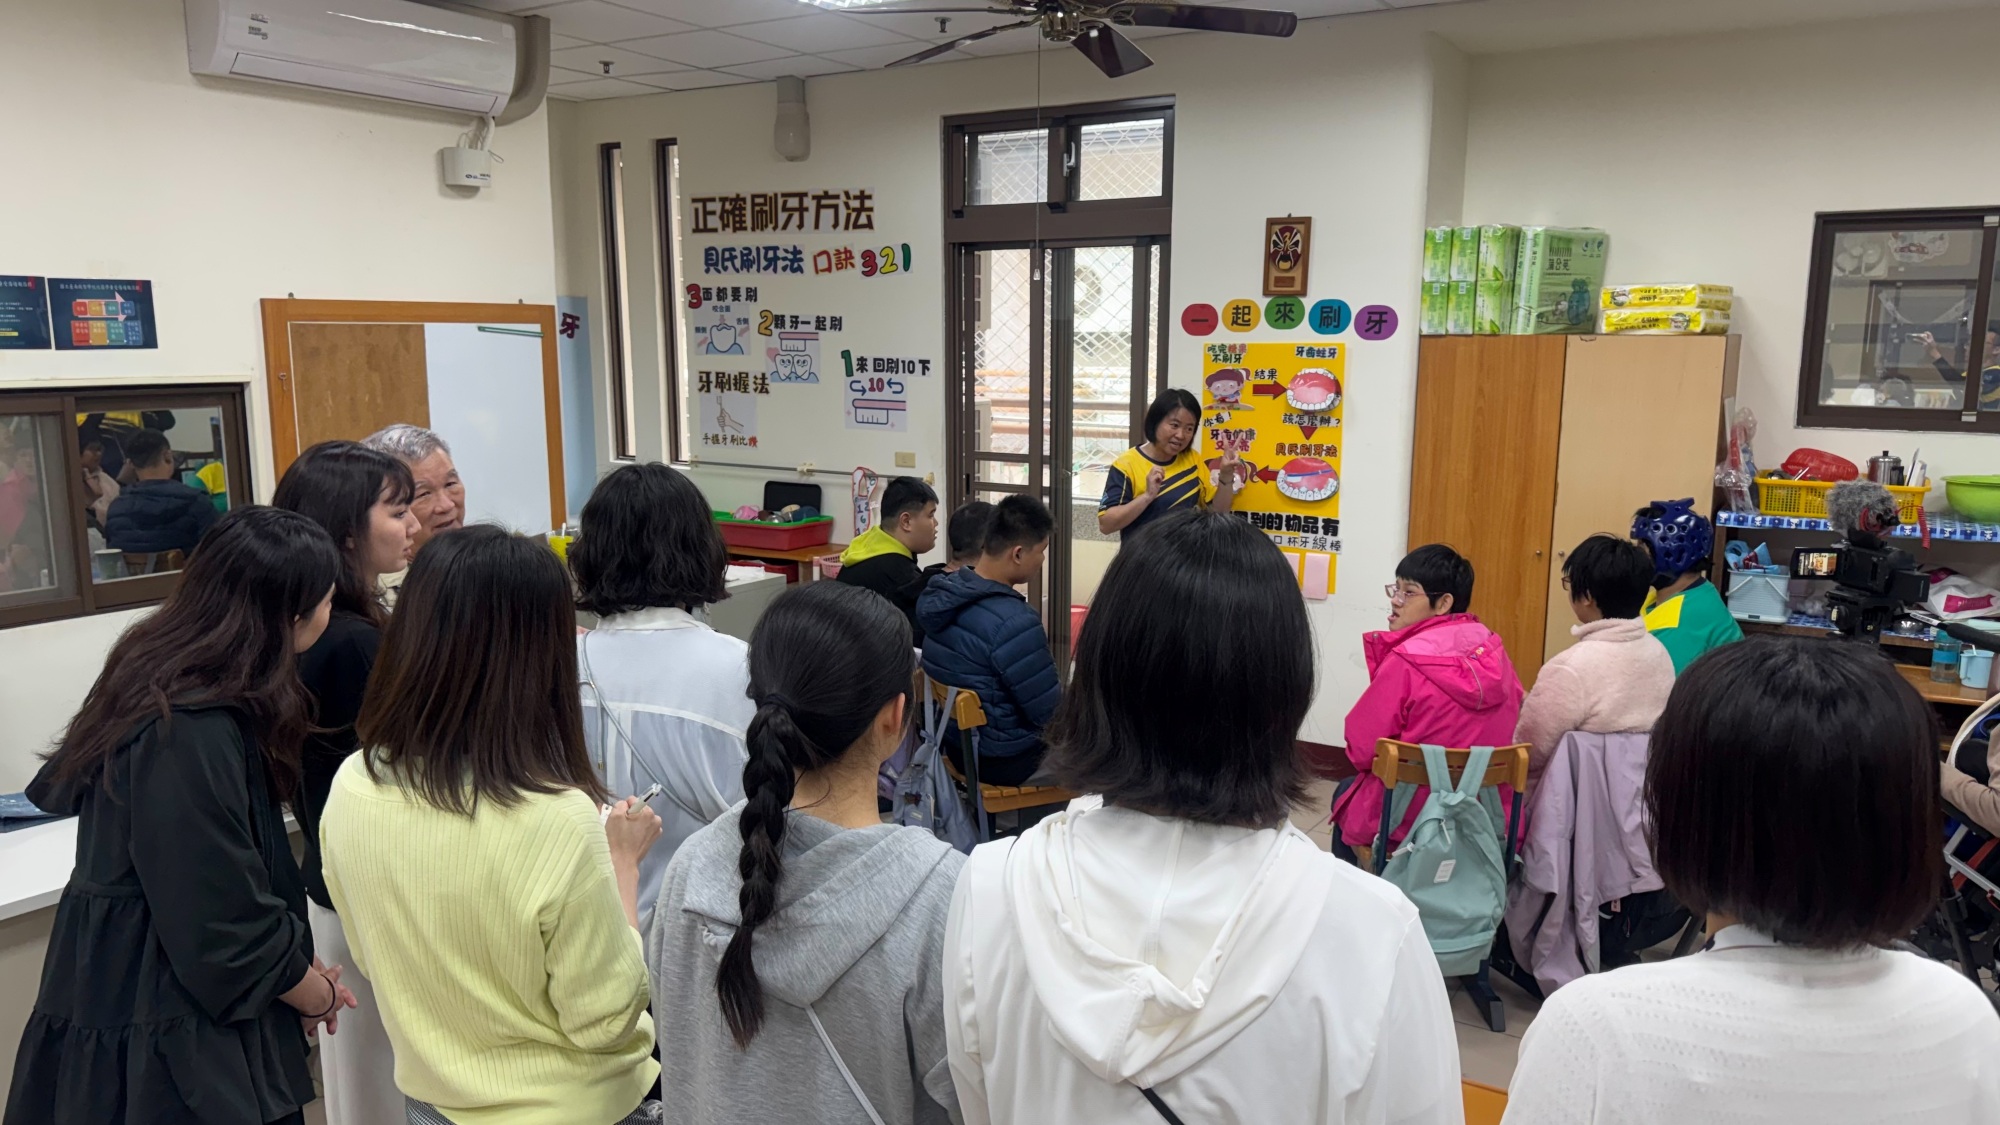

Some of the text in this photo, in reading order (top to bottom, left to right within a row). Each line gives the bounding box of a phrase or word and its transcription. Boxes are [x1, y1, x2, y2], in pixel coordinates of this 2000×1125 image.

[691, 189, 875, 234] 正確刷牙方法
[704, 243, 911, 277] 貝氏刷牙法 口訣 321
[757, 310, 842, 337] 2顆牙一起刷
[1190, 301, 1388, 335] 一起來刷牙
[1211, 353, 1242, 364] 不刷牙
[698, 370, 770, 395] 牙刷握法
[867, 377, 885, 392] 10
[1254, 368, 1278, 380] 結果
